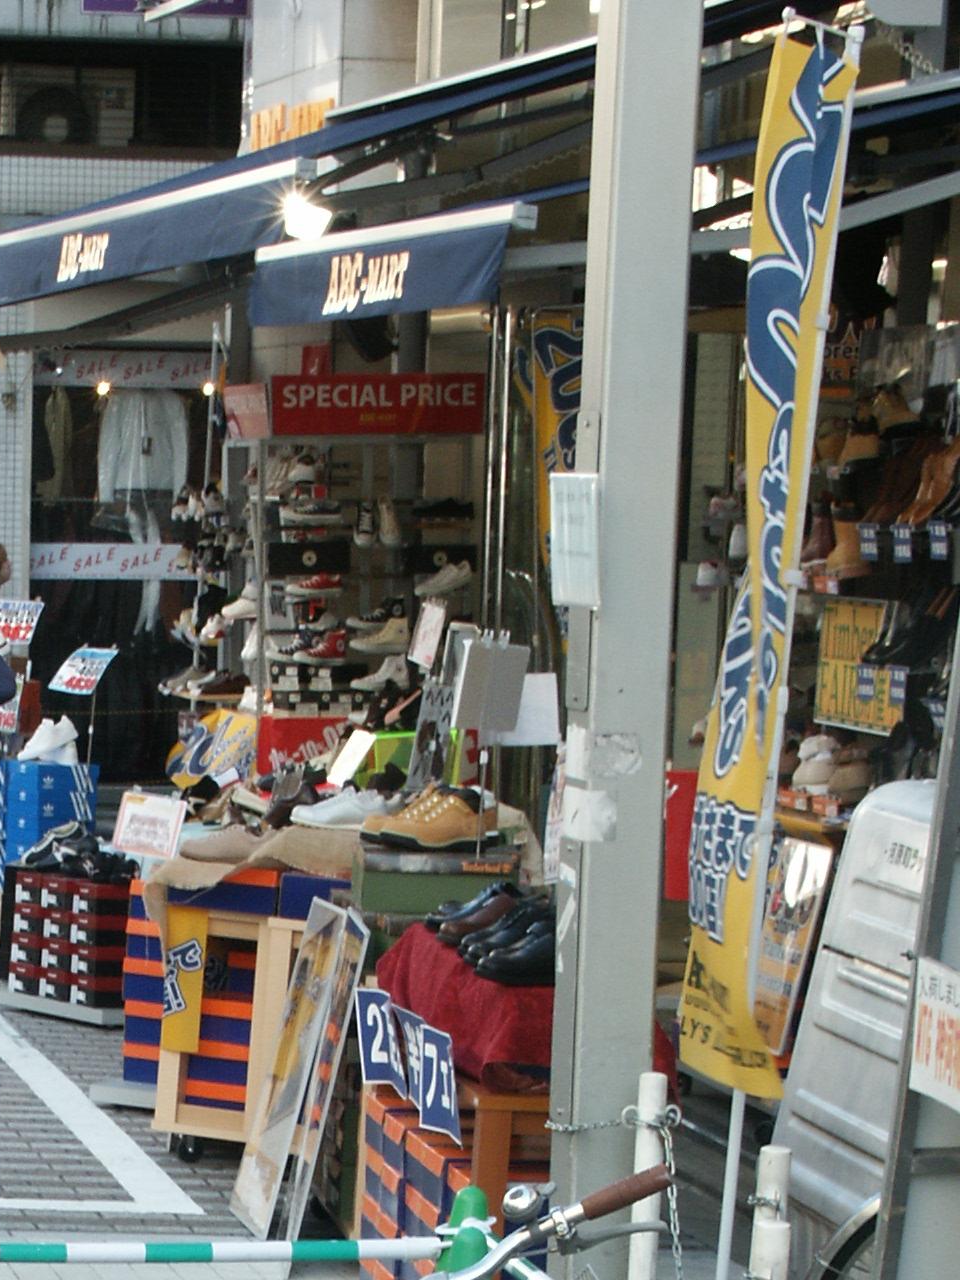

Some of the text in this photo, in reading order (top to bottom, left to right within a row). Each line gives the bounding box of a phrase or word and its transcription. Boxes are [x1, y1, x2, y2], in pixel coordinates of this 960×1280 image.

[321, 250, 410, 316] ABC-MART
[76, 355, 118, 380] SALE
[123, 354, 168, 380] SALE
[282, 383, 393, 409] SPECIAL
[400, 381, 476, 407] PRICE
[73, 546, 116, 573] SALE
[120, 547, 163, 574] SALE
